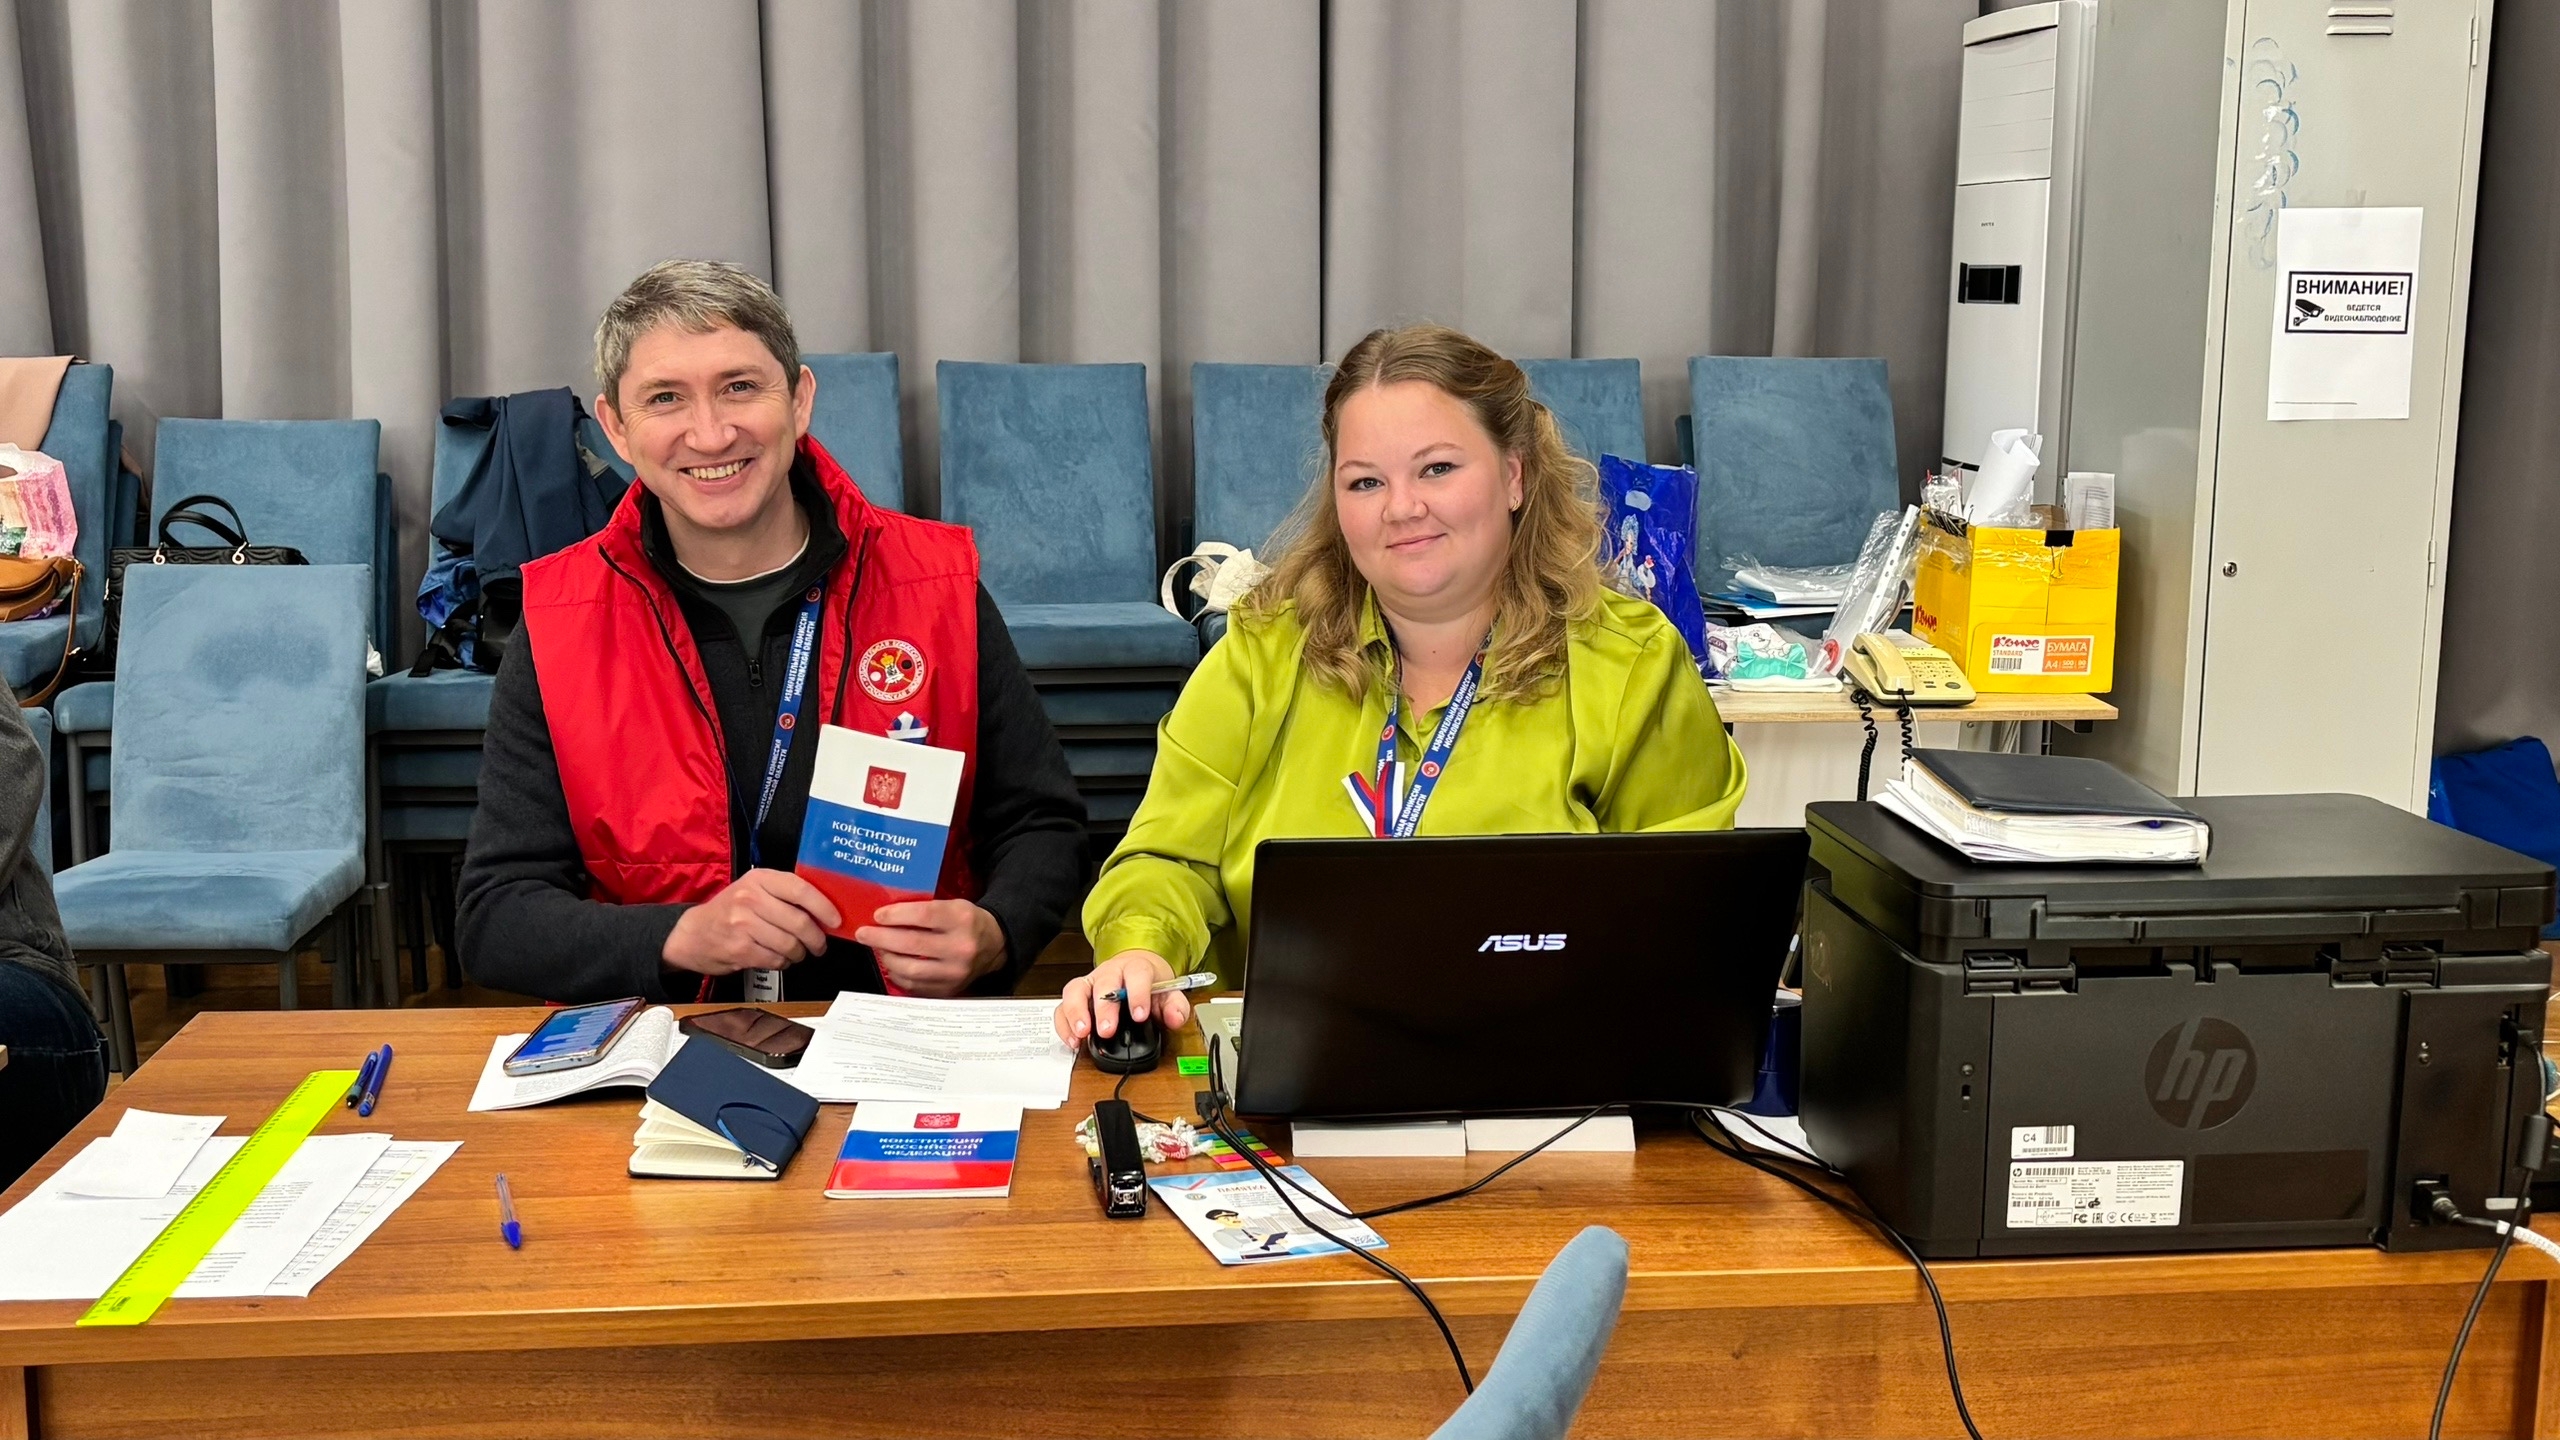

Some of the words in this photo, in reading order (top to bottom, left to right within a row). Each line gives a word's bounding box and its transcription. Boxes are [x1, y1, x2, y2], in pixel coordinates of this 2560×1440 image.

[2295, 279, 2404, 296] ВНИМАНИЕ!
[2324, 314, 2402, 323] ВИДЕОНАБЛЮДЕНИЕ
[2346, 304, 2381, 312] ВЕДЕТСЯ
[784, 647, 801, 702] ИЗБИРАТЕЛЬНАЯ
[795, 612, 809, 647] КОМИССИЯ
[793, 651, 810, 696] МОСКОВСКОЙ
[803, 621, 816, 651] ОБЛАСТИ
[2046, 642, 2088, 652] БУМАГА
[1431, 702, 1460, 752] ИЗБИРАТЕЛЬНАЯ
[1454, 670, 1473, 704] КОМИССИЯ
[1442, 708, 1466, 749] МОСКОВСКОЙ
[1461, 682, 1477, 709] ОБЛАСТИ
[1401, 784, 1422, 818] КОМИССИЯ
[1411, 793, 1427, 822] ОБЛАСТИ
[832, 820, 918, 847] КОНСТИТУЦИЯ
[832, 835, 911, 861] РОССИЙСКОЙ
[833, 850, 905, 874] ФЕДЕРАЦИИ
[1478, 934, 1567, 952] ASUS
[2153, 1018, 2250, 1130] hp
[2022, 1133, 2036, 1143] C4
